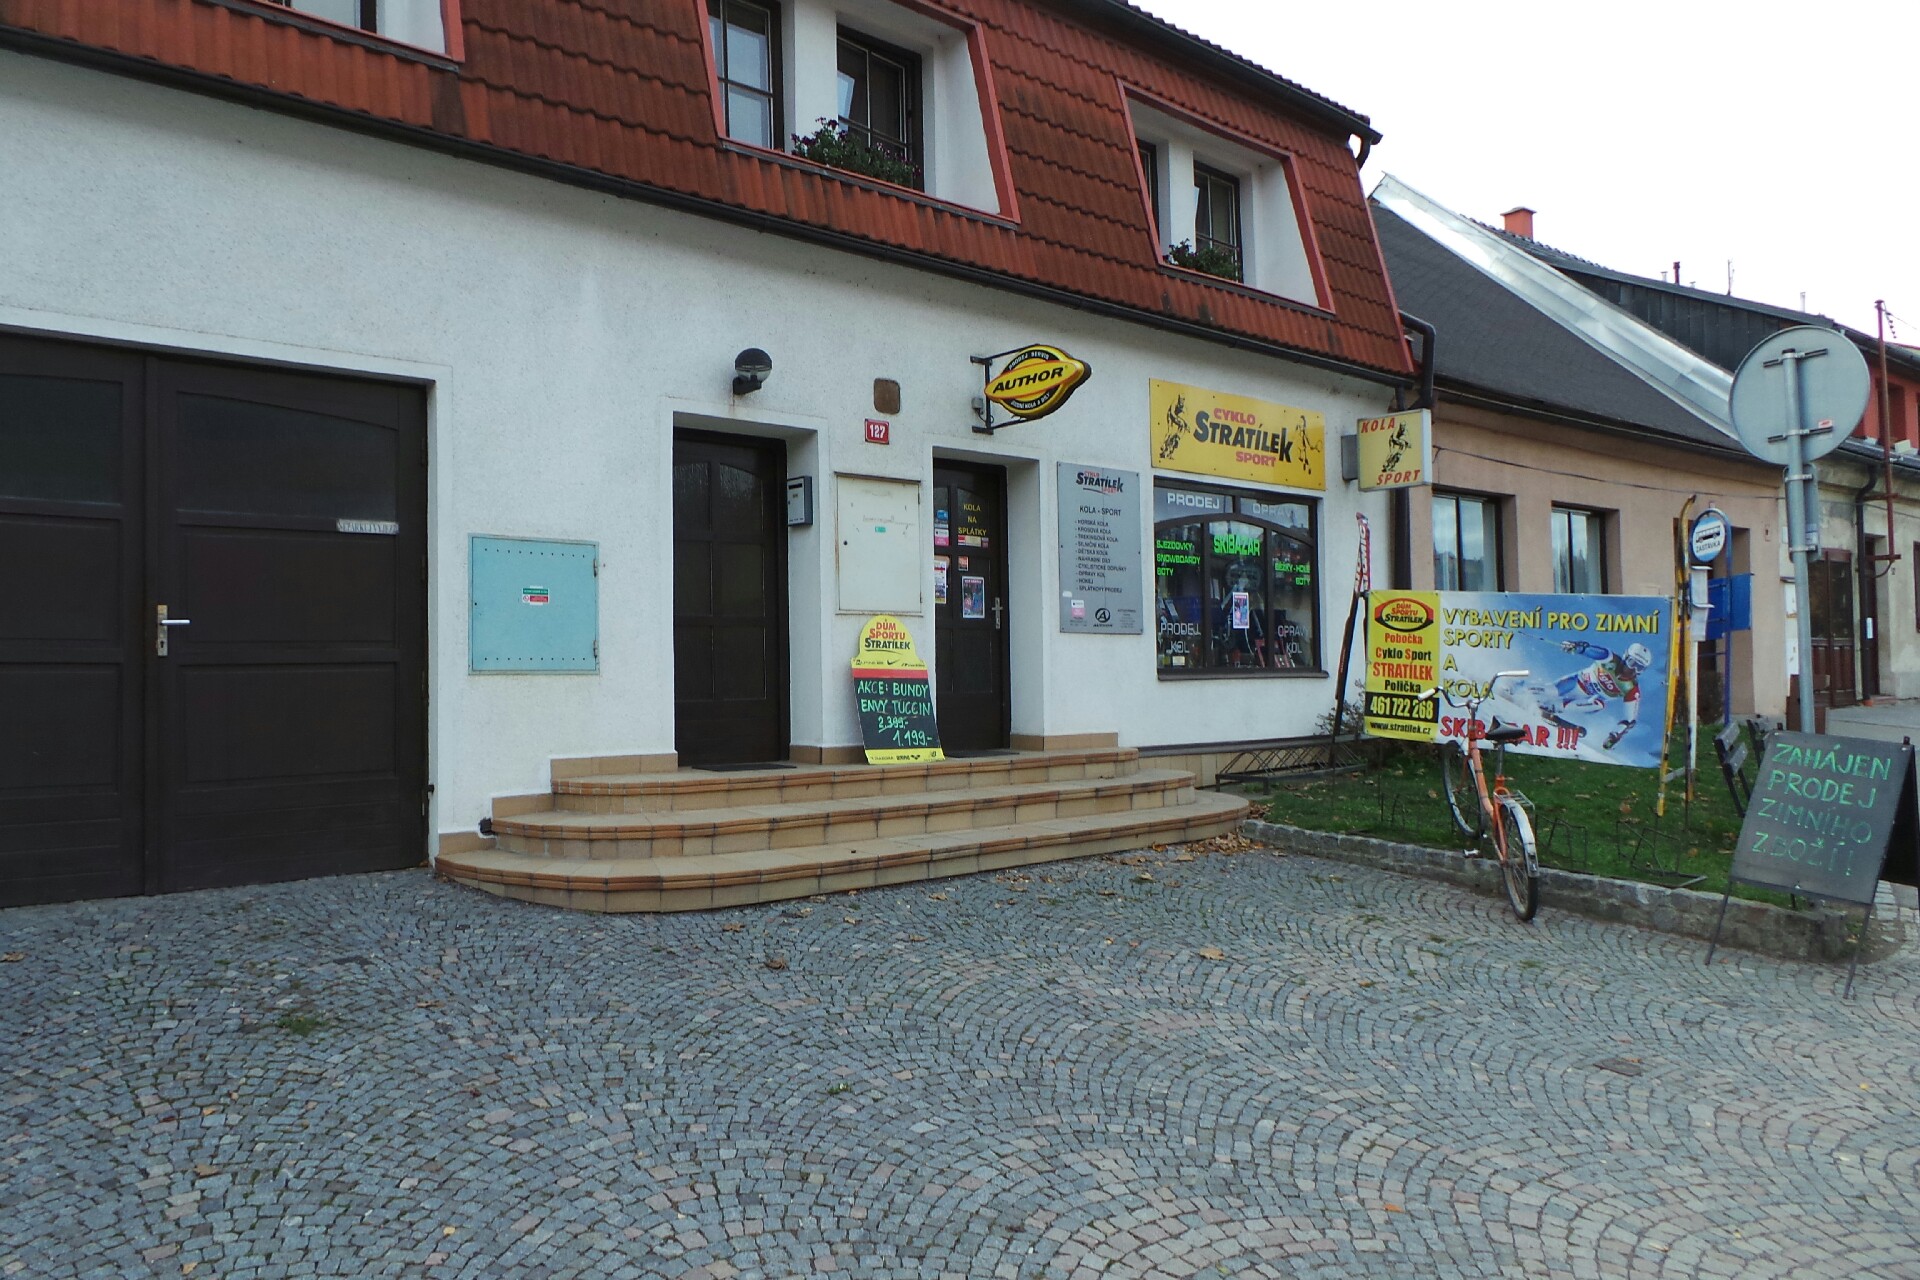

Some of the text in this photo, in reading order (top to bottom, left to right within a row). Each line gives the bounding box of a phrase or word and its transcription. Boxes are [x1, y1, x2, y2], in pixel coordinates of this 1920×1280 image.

[1008, 353, 1028, 370] PRODEJ
[993, 367, 1064, 394] AUTHOR
[1213, 407, 1256, 425] CYKLO
[869, 424, 886, 439] 127
[1361, 417, 1396, 434] KOLA
[1235, 450, 1278, 467] SPORT
[1376, 469, 1421, 486] SPORT
[963, 503, 982, 512] KOLA
[1167, 492, 1220, 510] PRODEJ
[1079, 505, 1096, 514] KOLA
[1101, 507, 1121, 516] SPORT
[967, 516, 977, 524] NA
[957, 527, 987, 536] SPLÁTKY
[1213, 533, 1261, 557] SKIBAZAR
[1156, 553, 1200, 565] SNOWBOARDY
[1157, 567, 1174, 577] BOTY
[1391, 608, 1418, 616] SPORTU
[1396, 601, 1412, 609] DŮM
[876, 619, 896, 631] DŮM
[1443, 606, 1660, 634] VYBAVENÍ PRO ZIMNÍ
[869, 629, 906, 640] SPORTU
[1160, 622, 1200, 636] PRODEJ
[864, 637, 911, 650] STRATÍLEK
[1170, 640, 1190, 654] KOL
[1384, 632, 1423, 645] Pobočka
[1443, 629, 1514, 649] SPORTY
[1286, 642, 1303, 654] KOL
[1376, 647, 1432, 662] Cyklo Sport
[1373, 660, 1433, 681] STRATÍLEK
[1443, 653, 1458, 672] A
[857, 681, 929, 699] AKCE: BUNDY
[1384, 679, 1422, 694] Polička
[1443, 679, 1495, 700] KOLA
[861, 699, 931, 717] ENVY TUCCIN
[1370, 696, 1434, 720] 461 722 268
[1370, 720, 1432, 736] www.stratilek.cz
[1440, 715, 1549, 748] SKIBAR
[1772, 744, 1892, 781] ZAHÁJEN
[1767, 769, 1877, 809] PRODEJ
[1757, 798, 1873, 844] ZIMNÍHO
